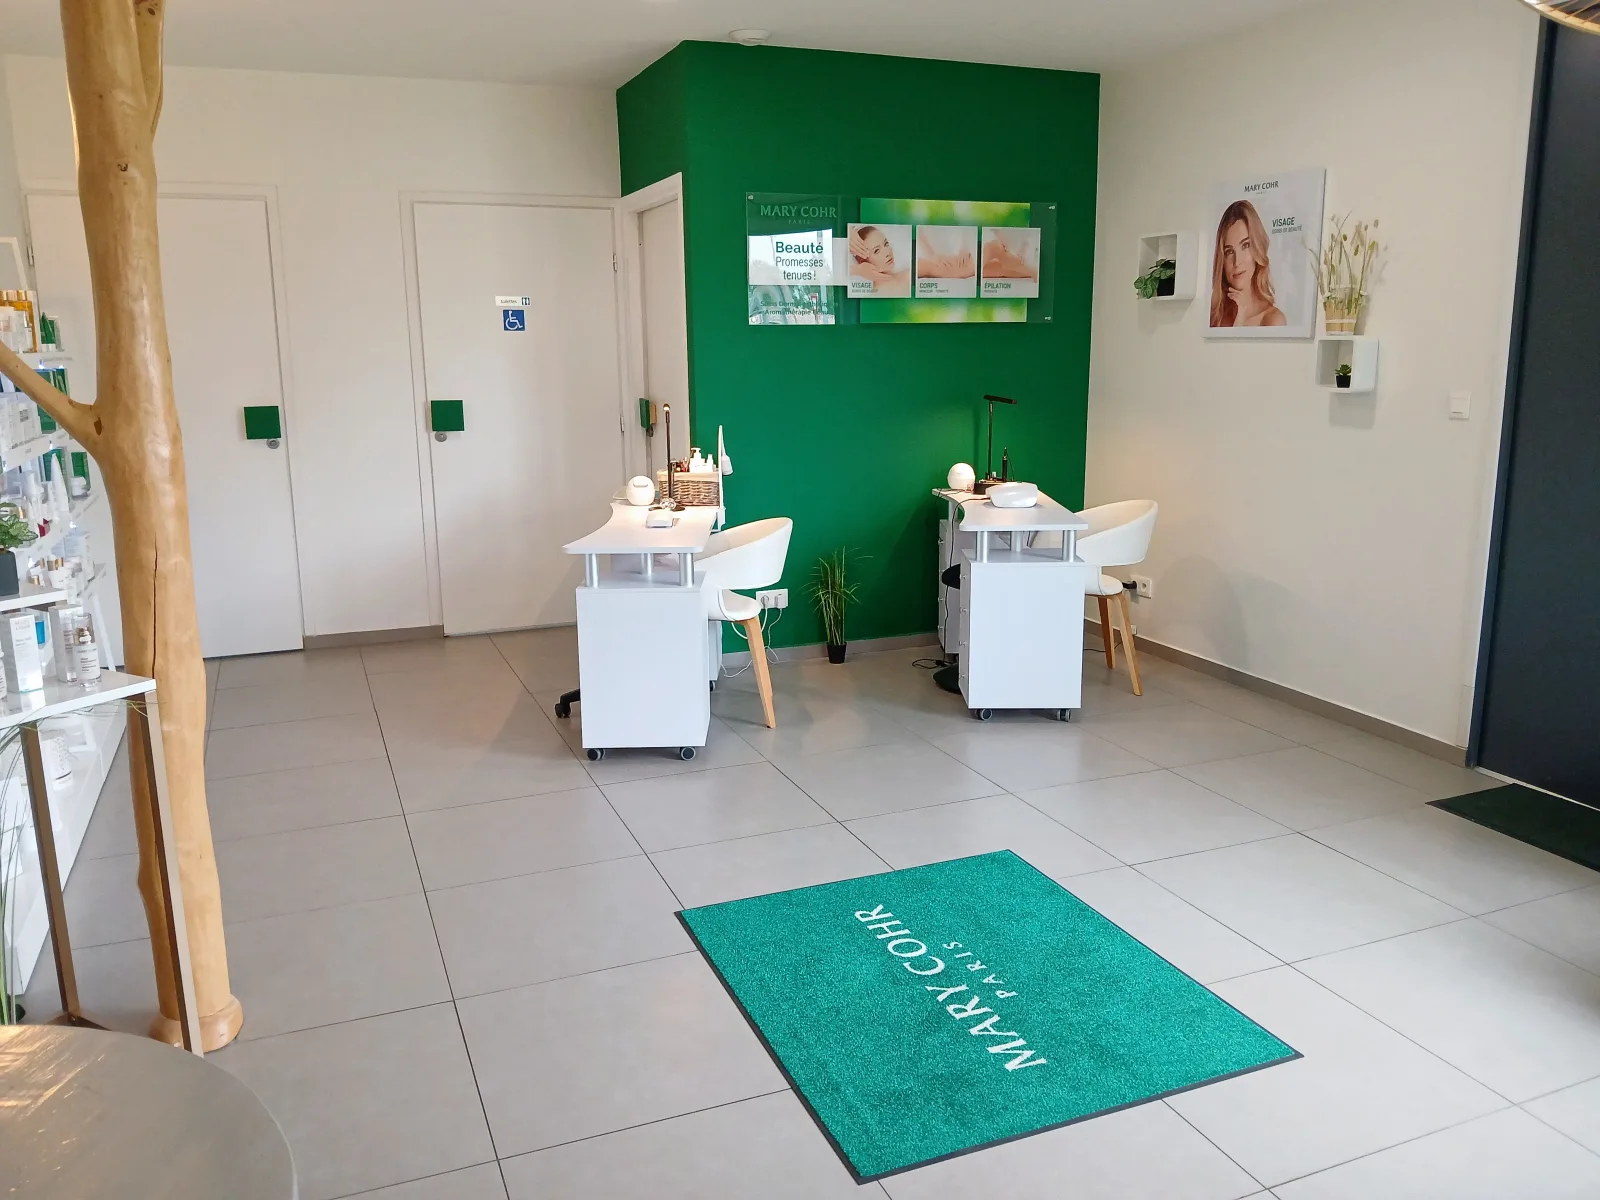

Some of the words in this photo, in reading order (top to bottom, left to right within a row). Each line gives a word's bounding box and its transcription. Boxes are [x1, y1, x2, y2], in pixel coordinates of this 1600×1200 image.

[1244, 184, 1261, 192] MARY
[1261, 180, 1279, 190] COHR
[760, 205, 797, 216] MARY
[800, 206, 837, 218] COHR
[1271, 216, 1295, 227] VISAGE
[775, 241, 824, 253] Beauté
[775, 256, 824, 267] Promesses
[984, 281, 1011, 289] ÉPILATION
[854, 904, 945, 975] COHR
[943, 941, 1018, 998] PARIS
[925, 984, 1047, 1072] MARY
